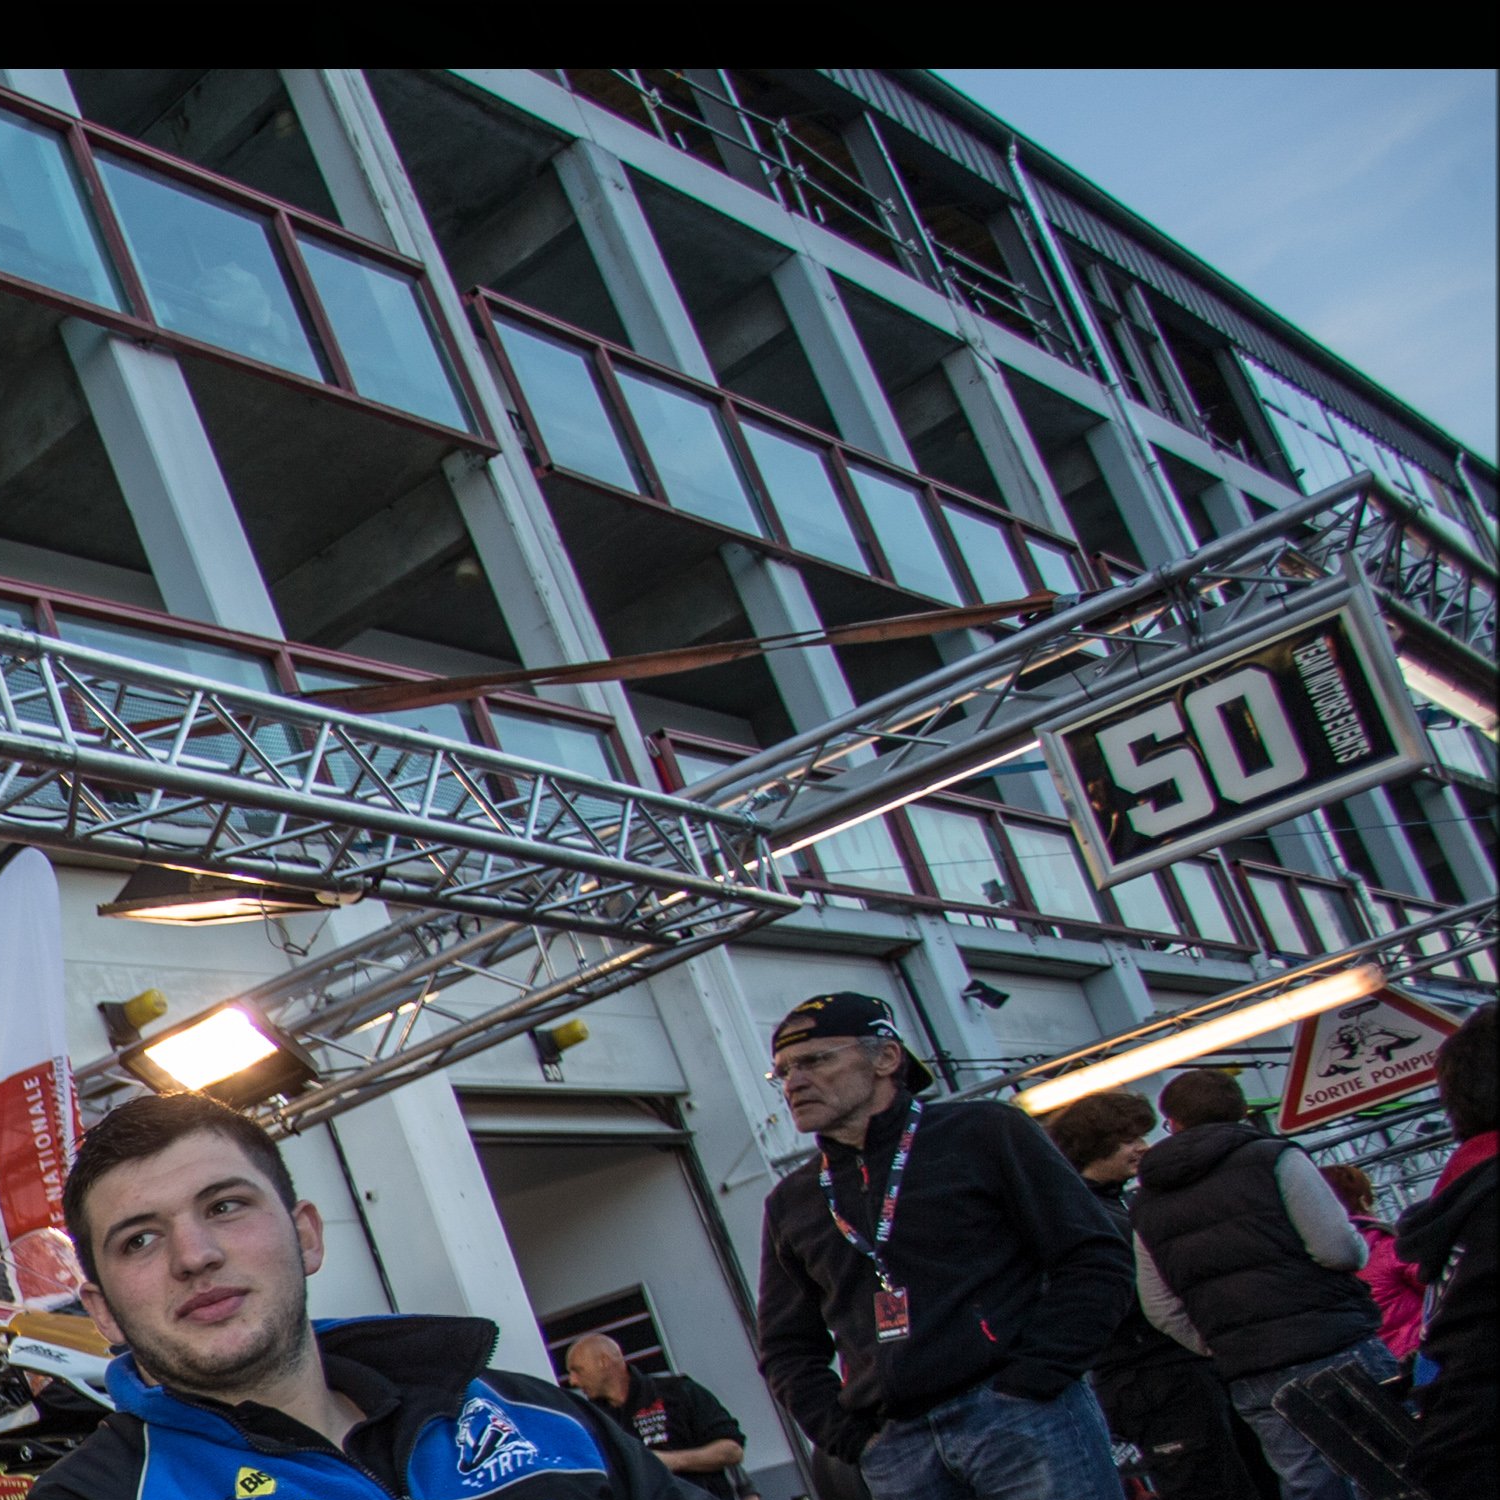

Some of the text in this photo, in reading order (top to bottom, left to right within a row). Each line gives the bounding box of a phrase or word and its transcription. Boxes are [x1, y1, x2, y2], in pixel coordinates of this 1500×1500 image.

[1095, 667, 1308, 838] 50
[1292, 636, 1371, 763] TEAM MOTORS EVENTS
[23, 1074, 64, 1203] NATIONALE
[1304, 1050, 1438, 1108] SORTIE POMPIE
